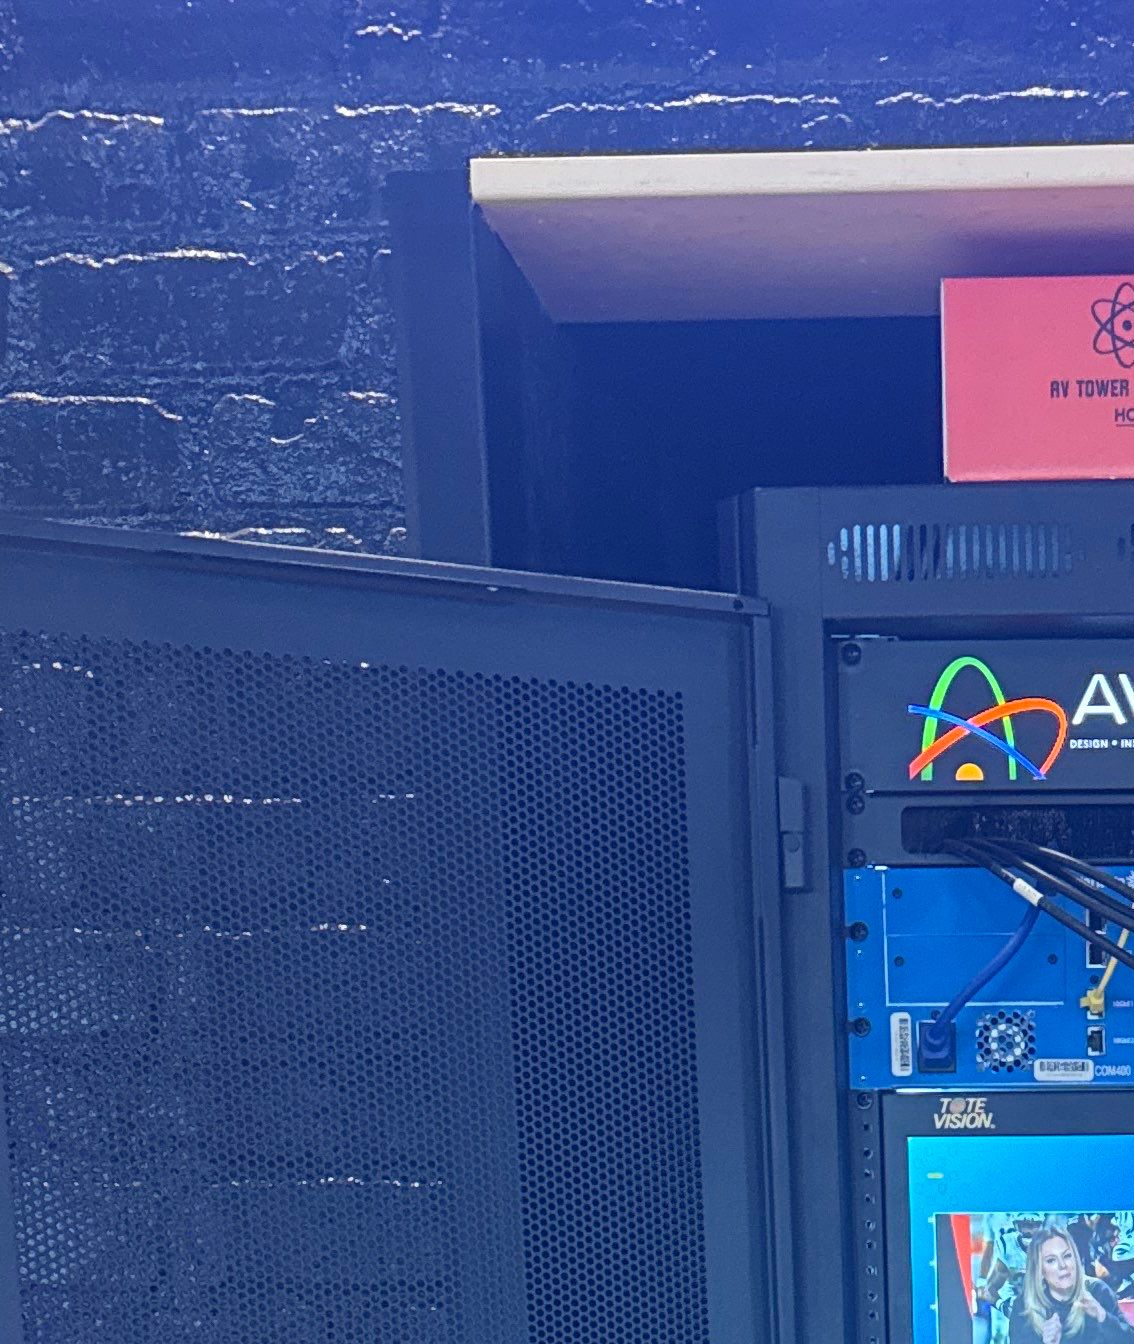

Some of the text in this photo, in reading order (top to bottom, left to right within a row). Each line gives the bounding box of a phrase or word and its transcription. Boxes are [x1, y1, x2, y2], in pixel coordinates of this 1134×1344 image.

[1050, 379, 1070, 399] AV
[1075, 378, 1130, 399] TOWER
[1069, 738, 1109, 750] DESIGN
[940, 1097, 988, 1114] TOTE
